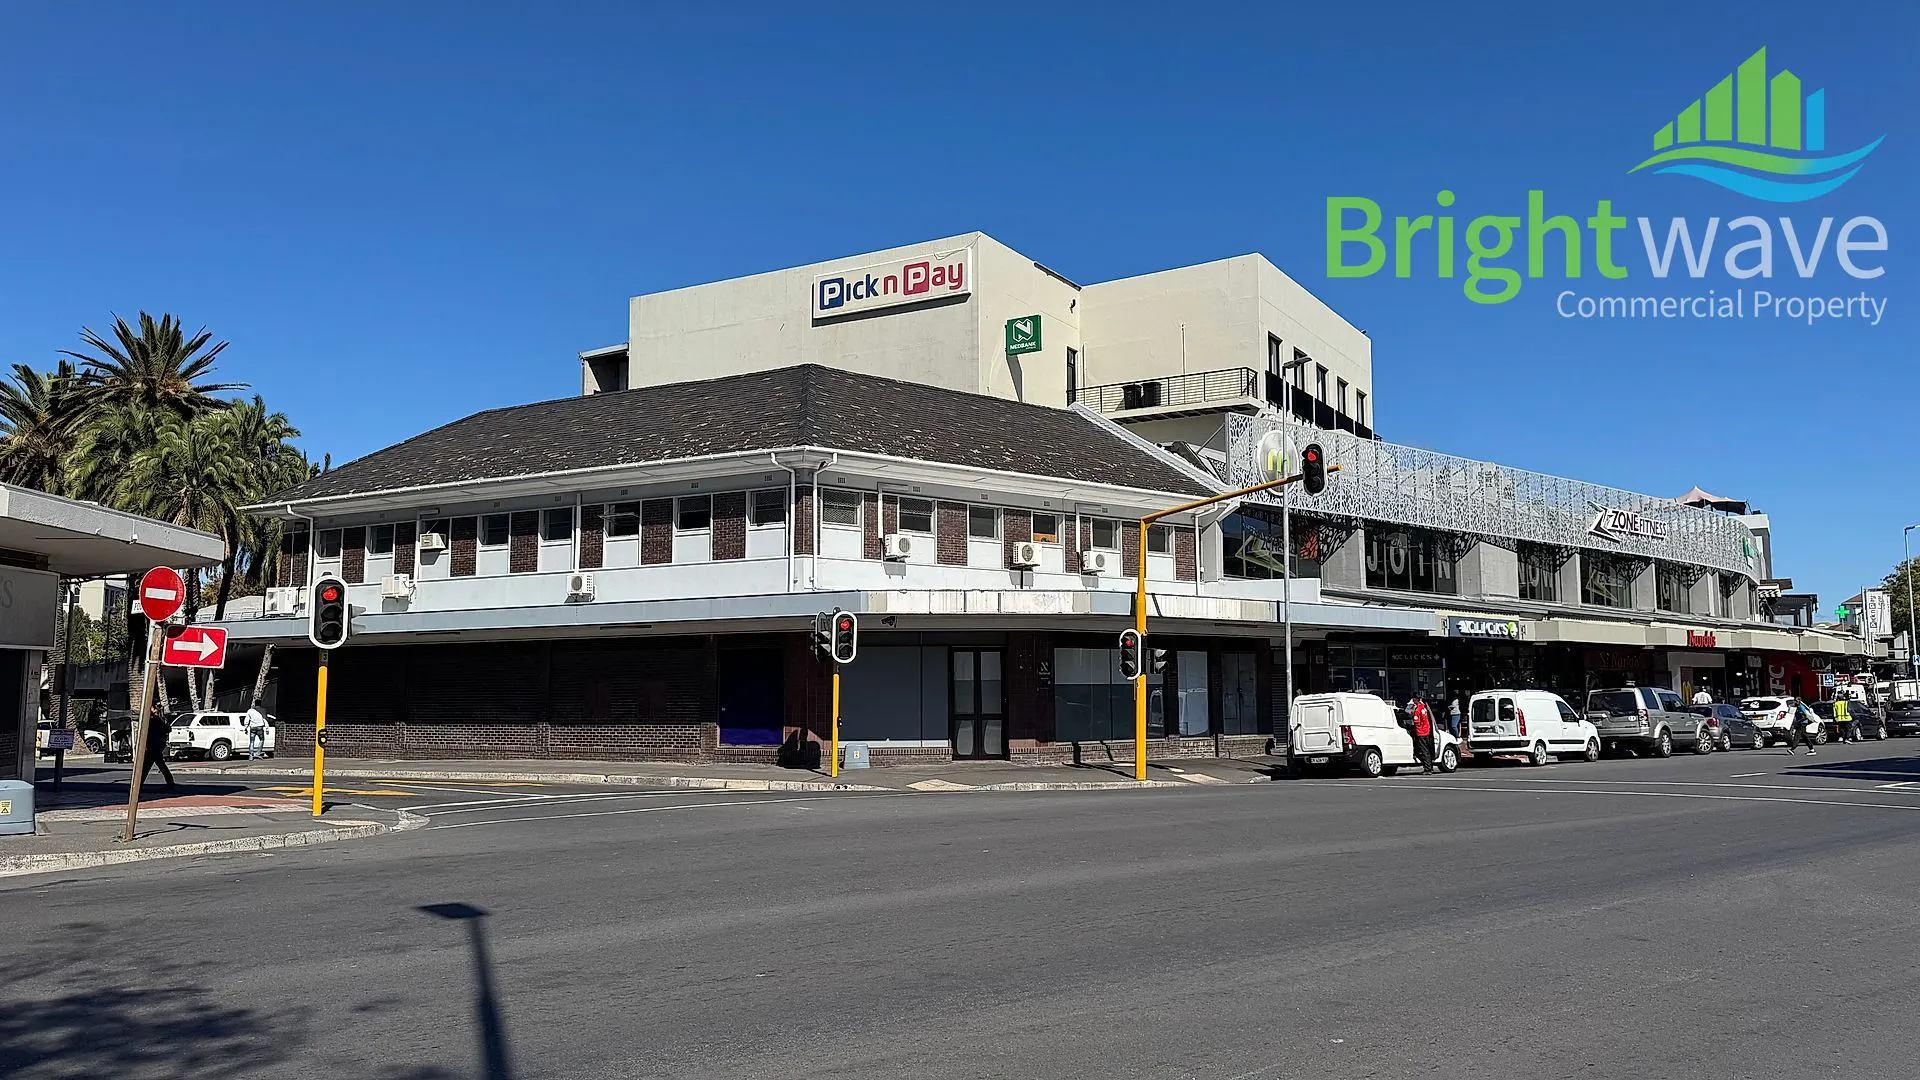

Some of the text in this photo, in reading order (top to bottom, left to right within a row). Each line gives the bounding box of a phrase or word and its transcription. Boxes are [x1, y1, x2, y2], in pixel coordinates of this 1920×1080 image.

[819, 261, 964, 311] Pick n Pay
